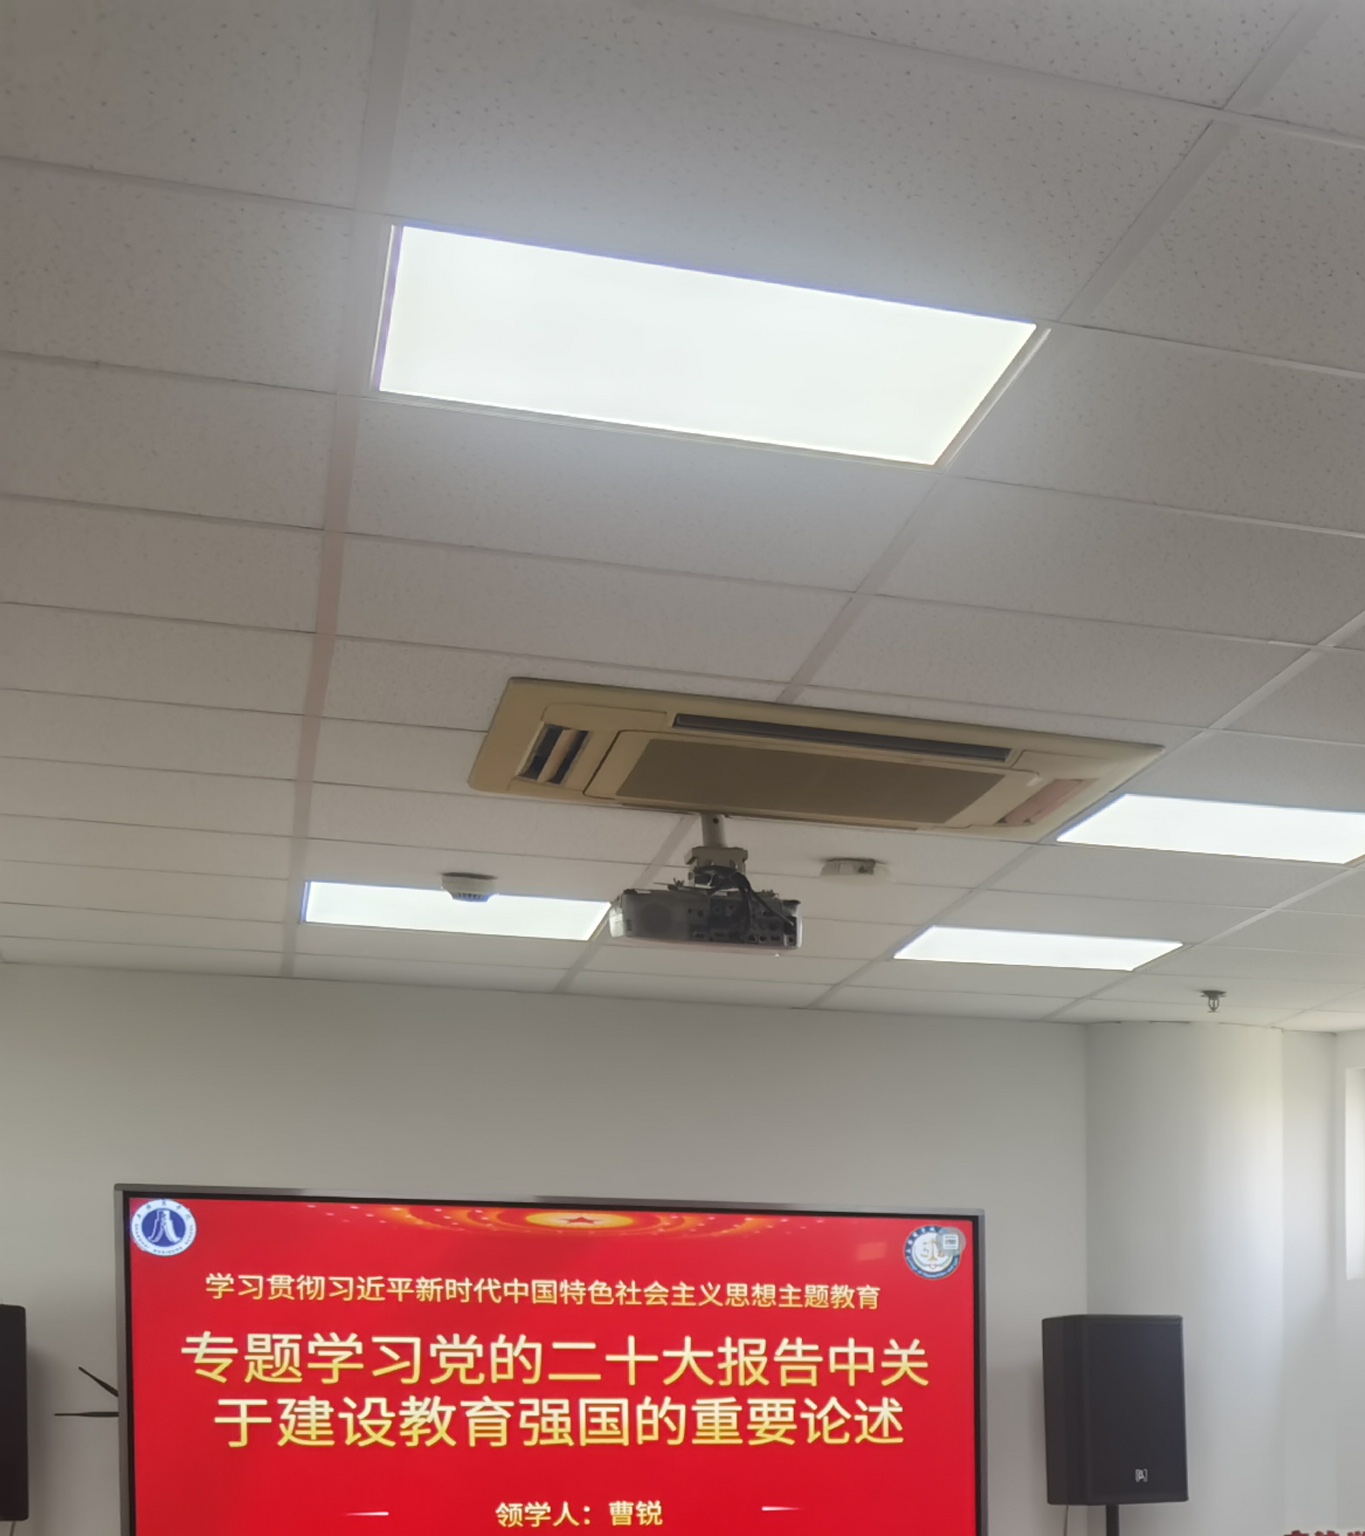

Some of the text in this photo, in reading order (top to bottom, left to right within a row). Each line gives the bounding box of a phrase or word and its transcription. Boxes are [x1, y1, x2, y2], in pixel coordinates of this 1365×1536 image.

[204, 1271, 881, 1311] 学习贯彻习近平新时代中国特色社会主义思想主题教育
[180, 1328, 930, 1388] 专题学习党的二十大报告中关
[213, 1394, 904, 1449] 于建设教育强国的重要论述
[495, 1500, 664, 1529] 领学人：曹锐
